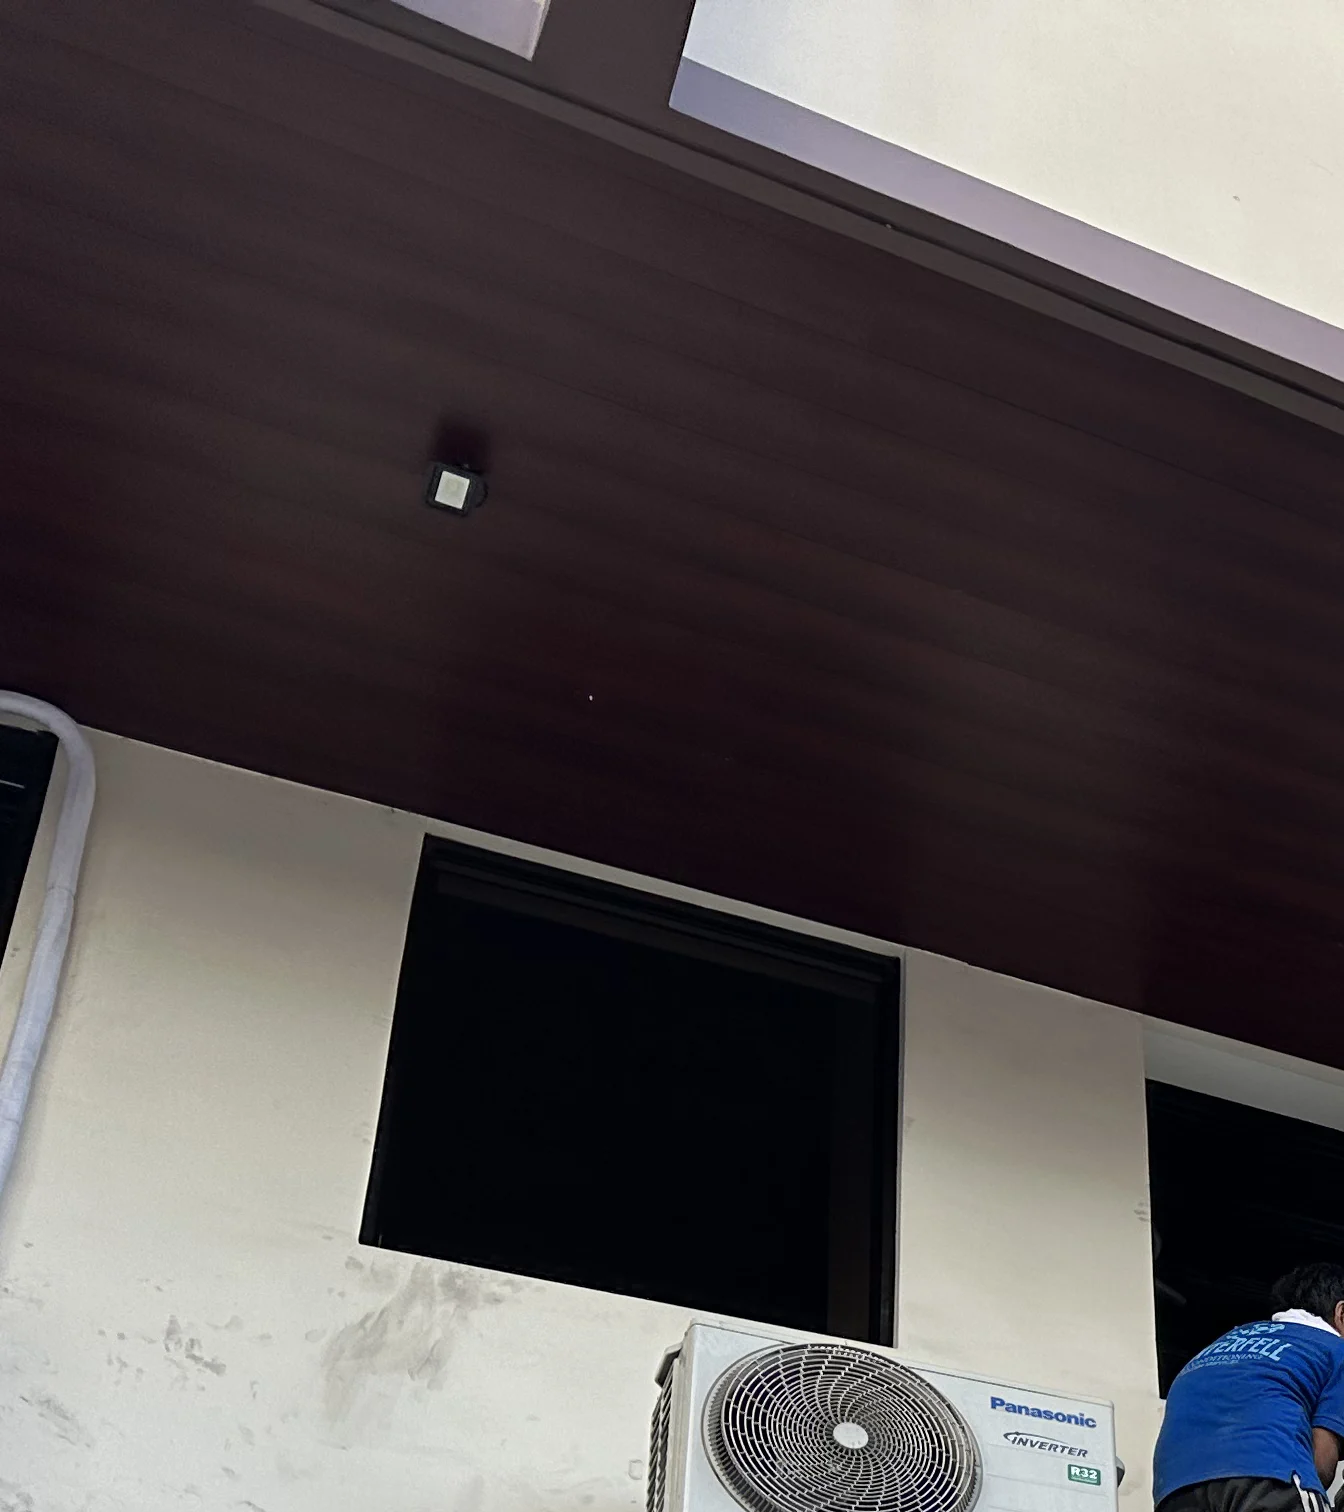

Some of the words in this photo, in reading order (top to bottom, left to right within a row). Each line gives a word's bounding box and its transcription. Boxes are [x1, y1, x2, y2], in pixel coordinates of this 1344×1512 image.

[990, 1396, 1097, 1428] Panasonic
[1011, 1435, 1089, 1458] INVERTER
[1070, 1466, 1098, 1480] R32
